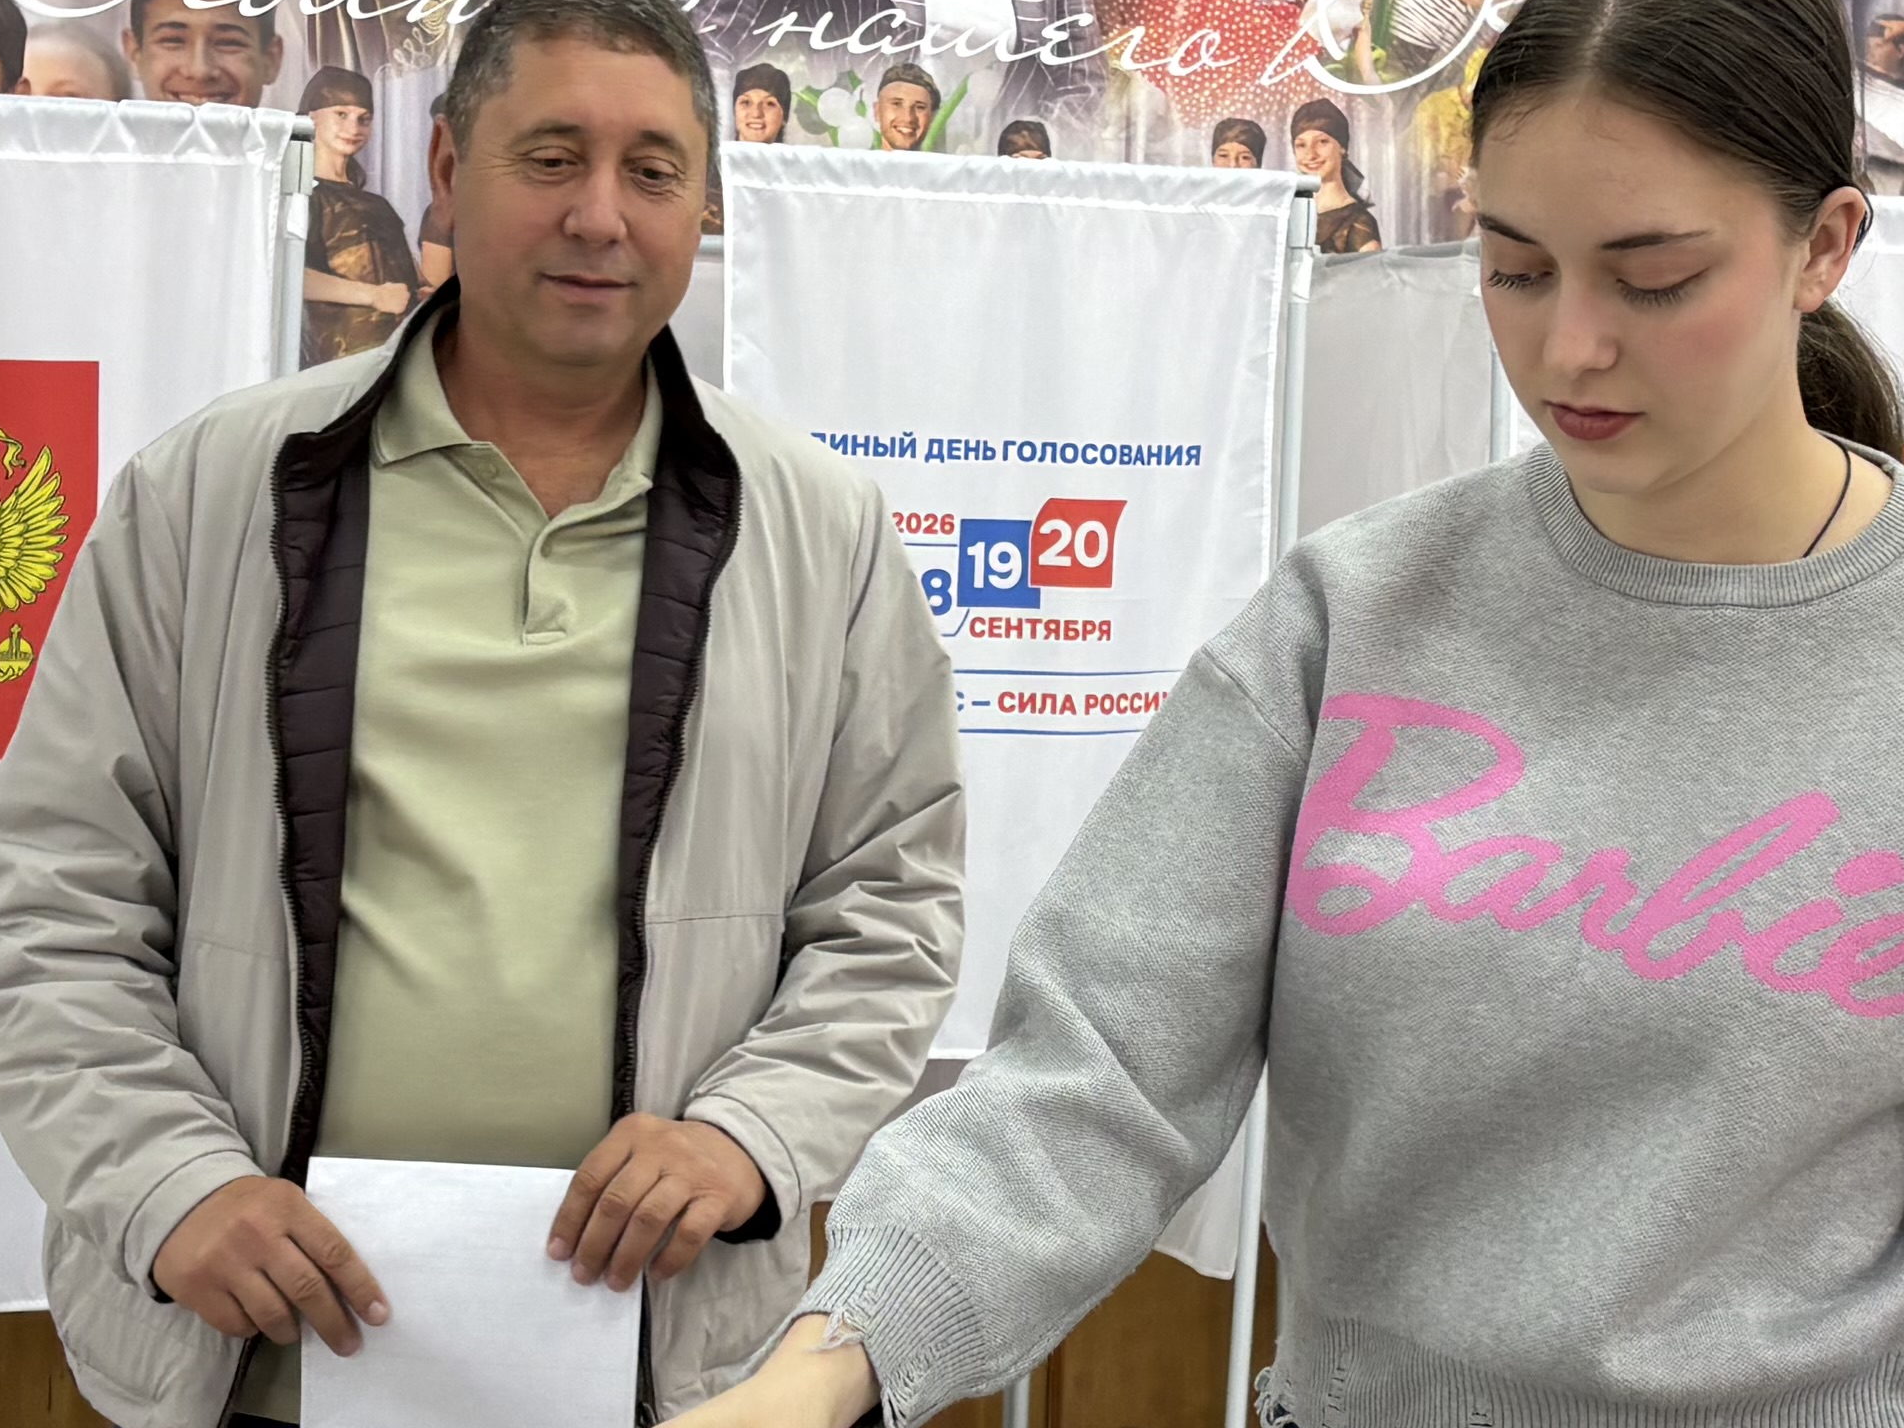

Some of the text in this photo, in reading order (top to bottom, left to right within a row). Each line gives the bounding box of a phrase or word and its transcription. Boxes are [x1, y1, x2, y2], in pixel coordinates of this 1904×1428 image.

[811, 432, 1202, 467] ИНЫЙ ДЕНЬ ГОЛОСОВАНИЯ
[892, 512, 955, 536] 2026
[921, 519, 1109, 616] 8 19 20
[969, 617, 1112, 642] СЕНТЯБРЯ
[997, 691, 1169, 716] СИЛА РОССИ
